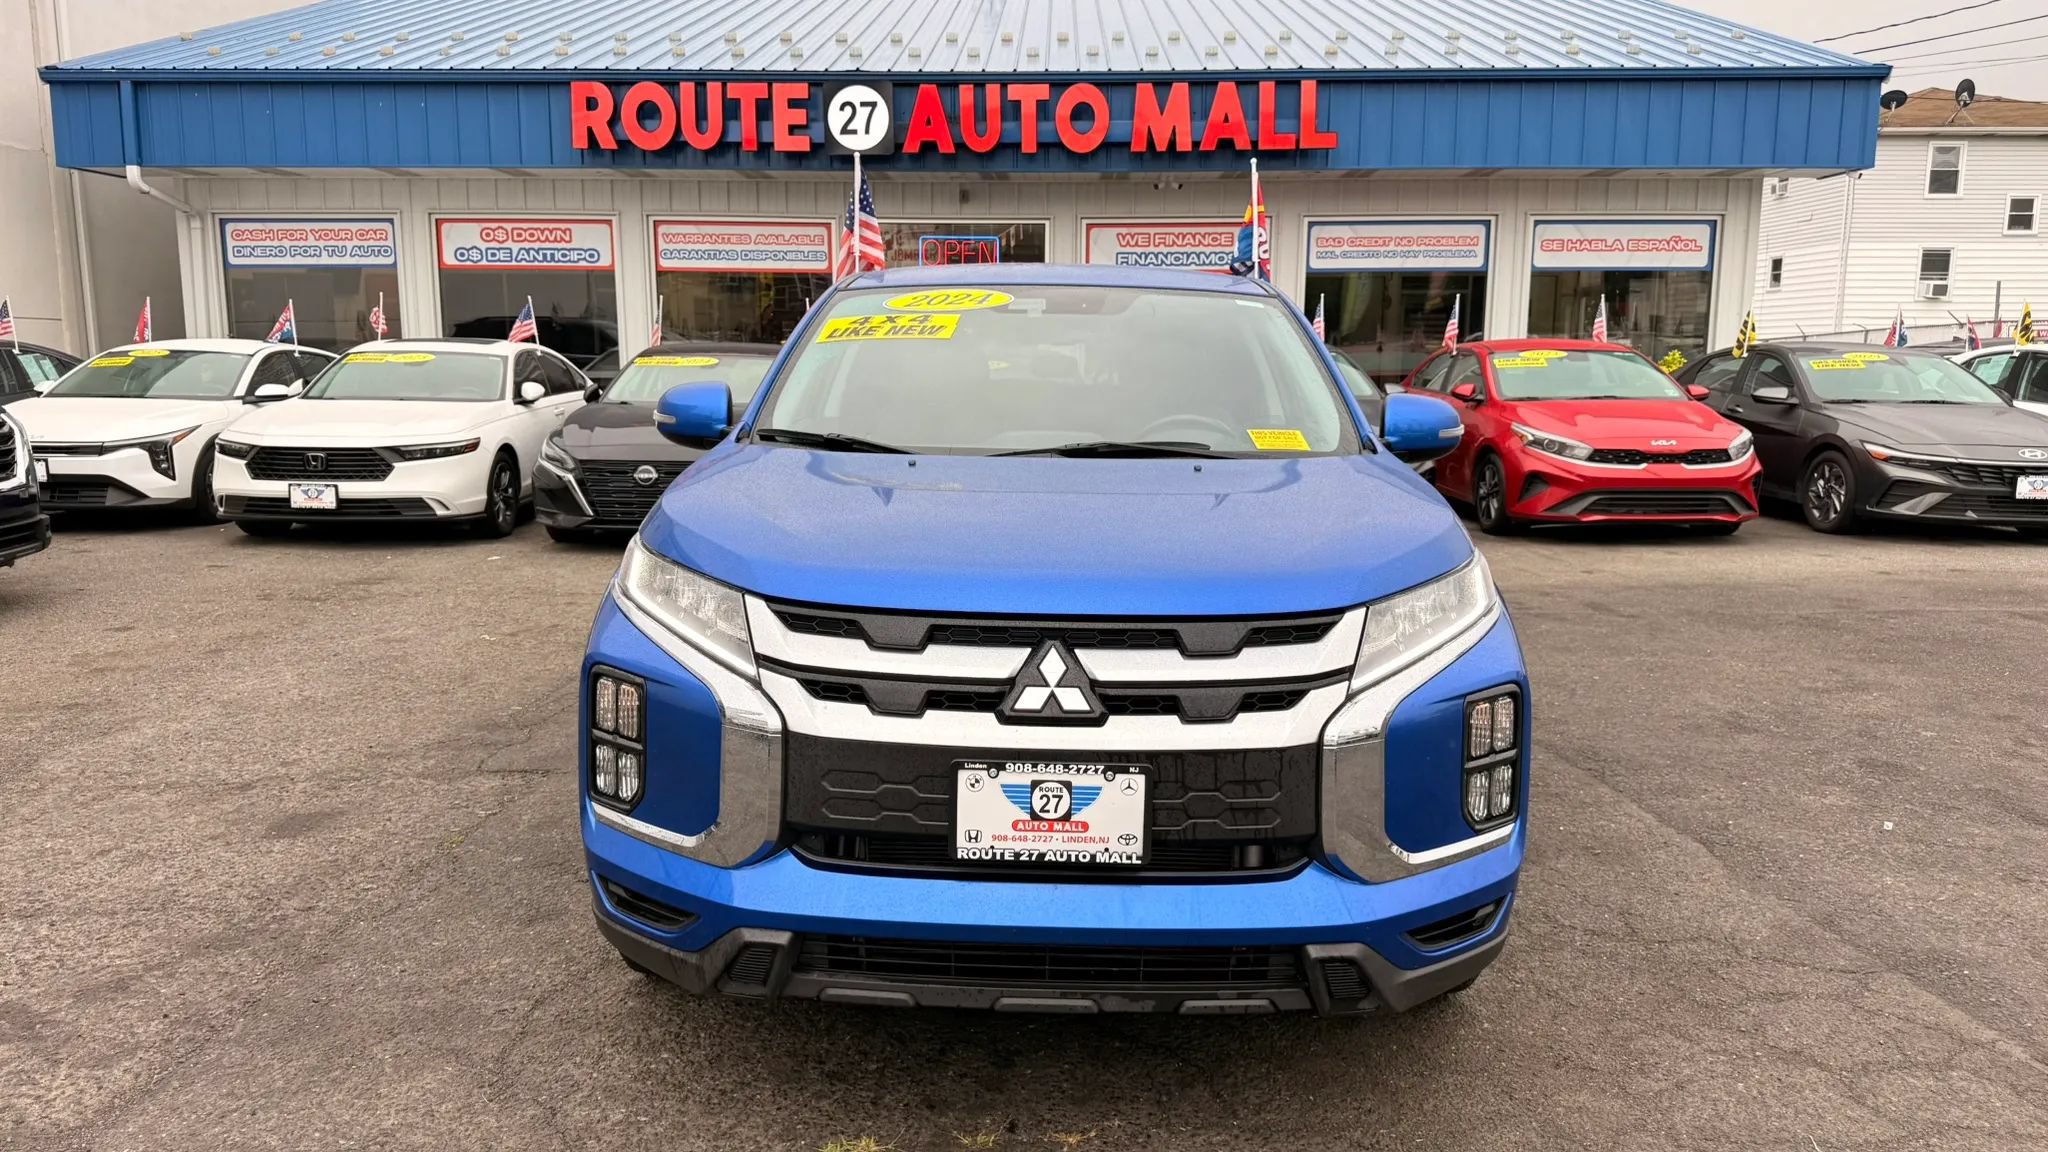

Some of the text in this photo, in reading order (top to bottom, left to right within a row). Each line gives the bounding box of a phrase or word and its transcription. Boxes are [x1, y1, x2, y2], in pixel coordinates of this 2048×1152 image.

[570, 80, 1338, 154] ROUTE 27 AUTO MALL
[231, 228, 389, 242] CASH FOR YOUR CAR
[511, 227, 572, 244] DOWN
[662, 232, 825, 246] WARRANTIES AVAILABLE
[1116, 232, 1235, 248] WE FINANCE
[1316, 235, 1480, 248] BAD CREDIT NO PROBLEM
[1541, 235, 1703, 252] SE HABLA ESPAÑOL
[233, 244, 393, 258] DINERO POR TU AUTO
[485, 247, 513, 263] DE
[514, 248, 600, 264] ANTICIPO
[660, 249, 828, 262] GARANTIAS DISPONIBLES
[922, 239, 998, 266] OPEN
[1316, 250, 1478, 259] MAL CREDITO NO HAY PROBLEMA
[903, 293, 994, 308] 2024
[849, 316, 868, 326] 4
[908, 314, 932, 324] 4
[826, 324, 946, 339] LIKE NEW
[1005, 763, 1105, 775] 908-648-2727
[1039, 794, 1063, 814] 27
[1017, 821, 1085, 832] AUTO MALL
[991, 834, 1053, 843] 908-648-2727
[957, 847, 1142, 864] ROUTE 27 AUTO MALL
